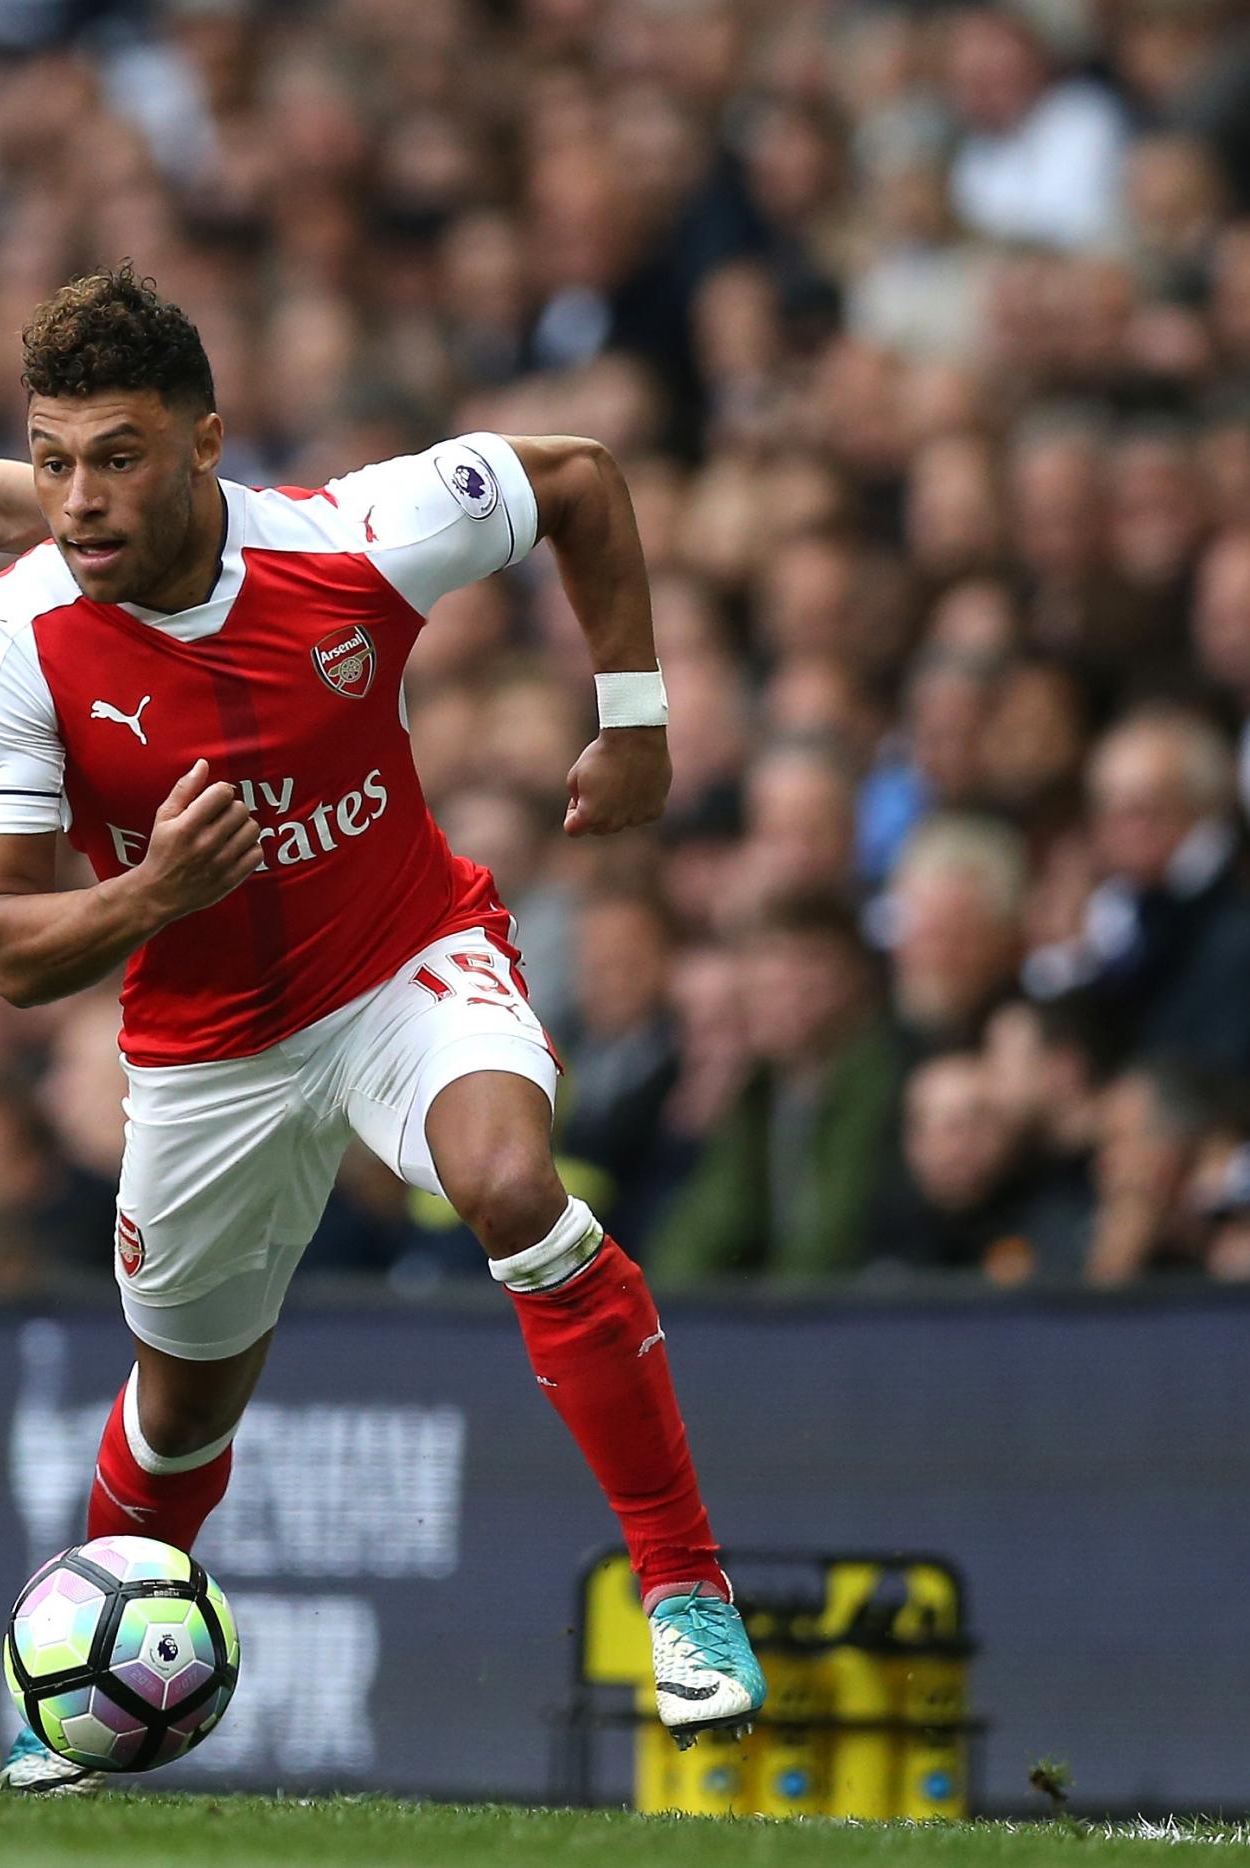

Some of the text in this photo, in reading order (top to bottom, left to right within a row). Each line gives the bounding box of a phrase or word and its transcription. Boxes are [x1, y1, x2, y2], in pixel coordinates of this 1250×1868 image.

[320, 633, 363, 664] Arsenal
[232, 777, 294, 815] ly
[105, 768, 388, 872] Erates
[409, 951, 513, 1003] 15
